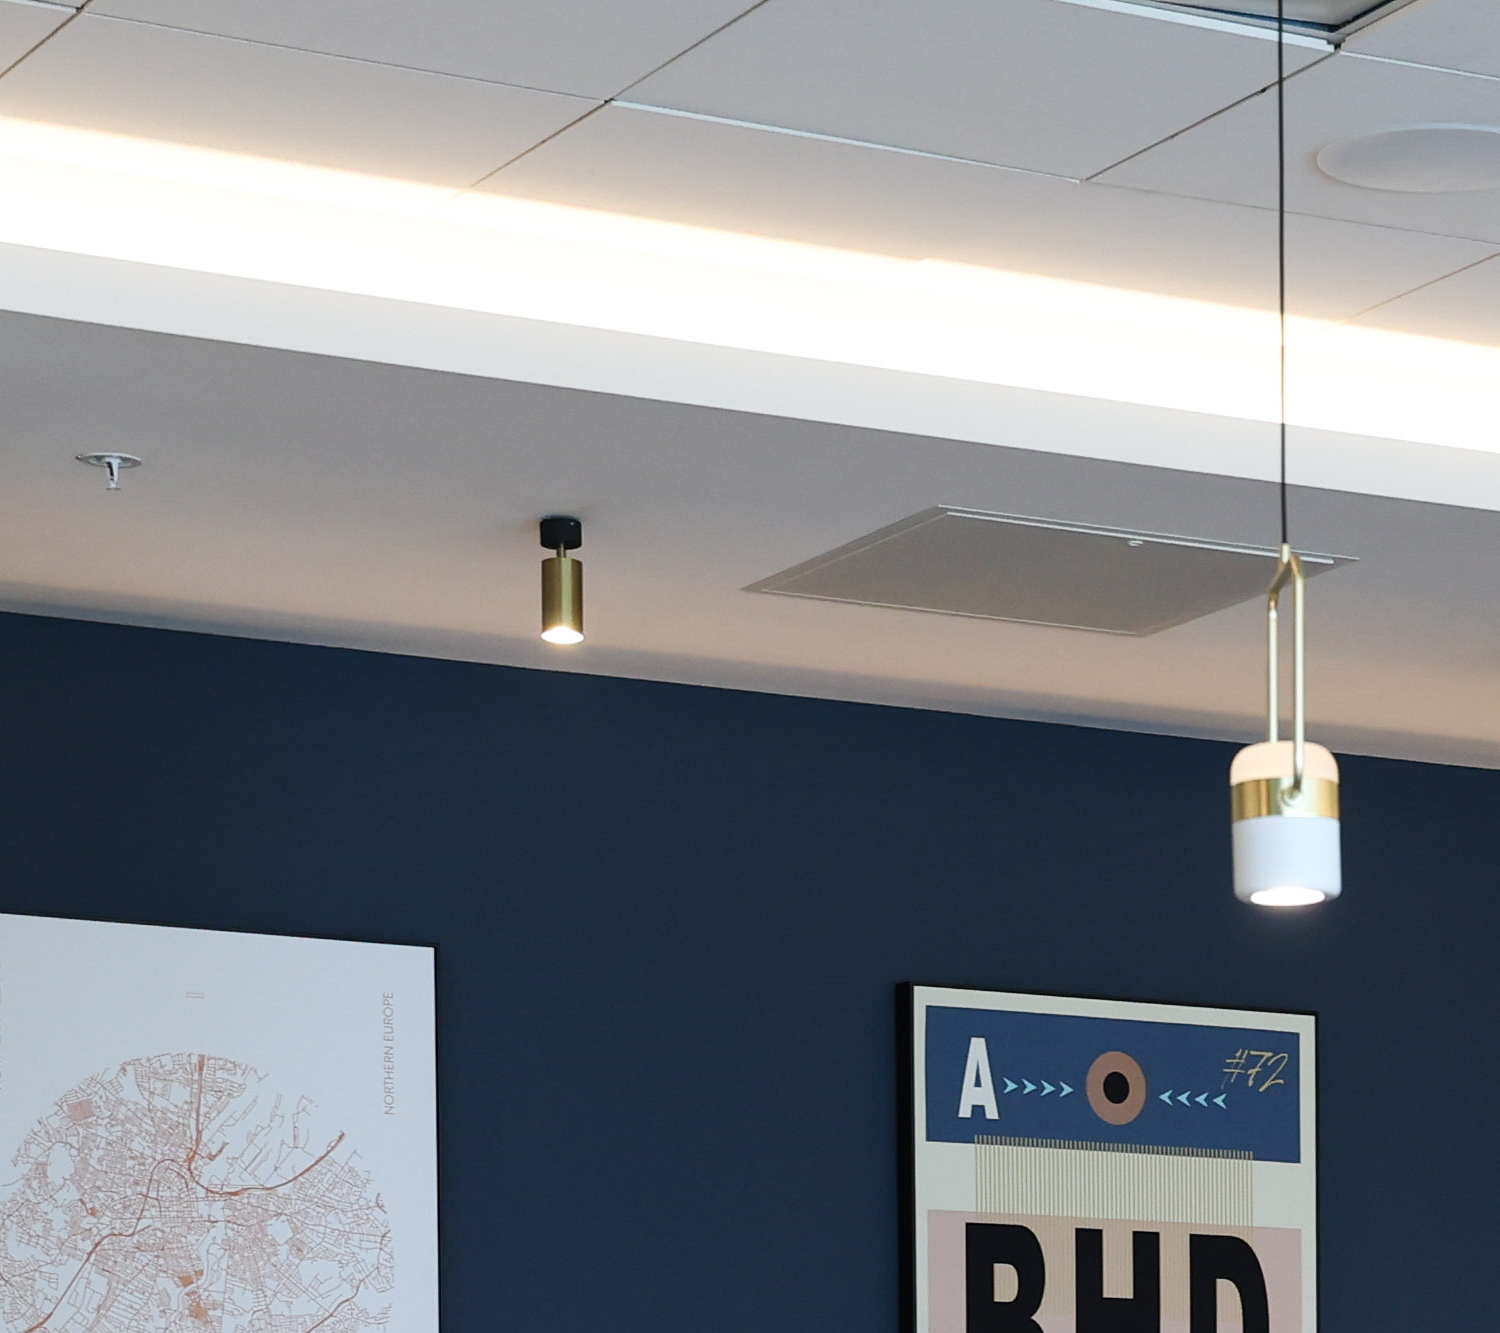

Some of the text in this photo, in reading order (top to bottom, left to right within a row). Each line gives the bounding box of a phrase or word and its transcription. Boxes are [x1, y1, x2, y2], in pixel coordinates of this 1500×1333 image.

[382, 991, 395, 1116] NORTHERN EUROPE
[958, 1036, 1000, 1120] A
[1220, 1048, 1289, 1092] #72
